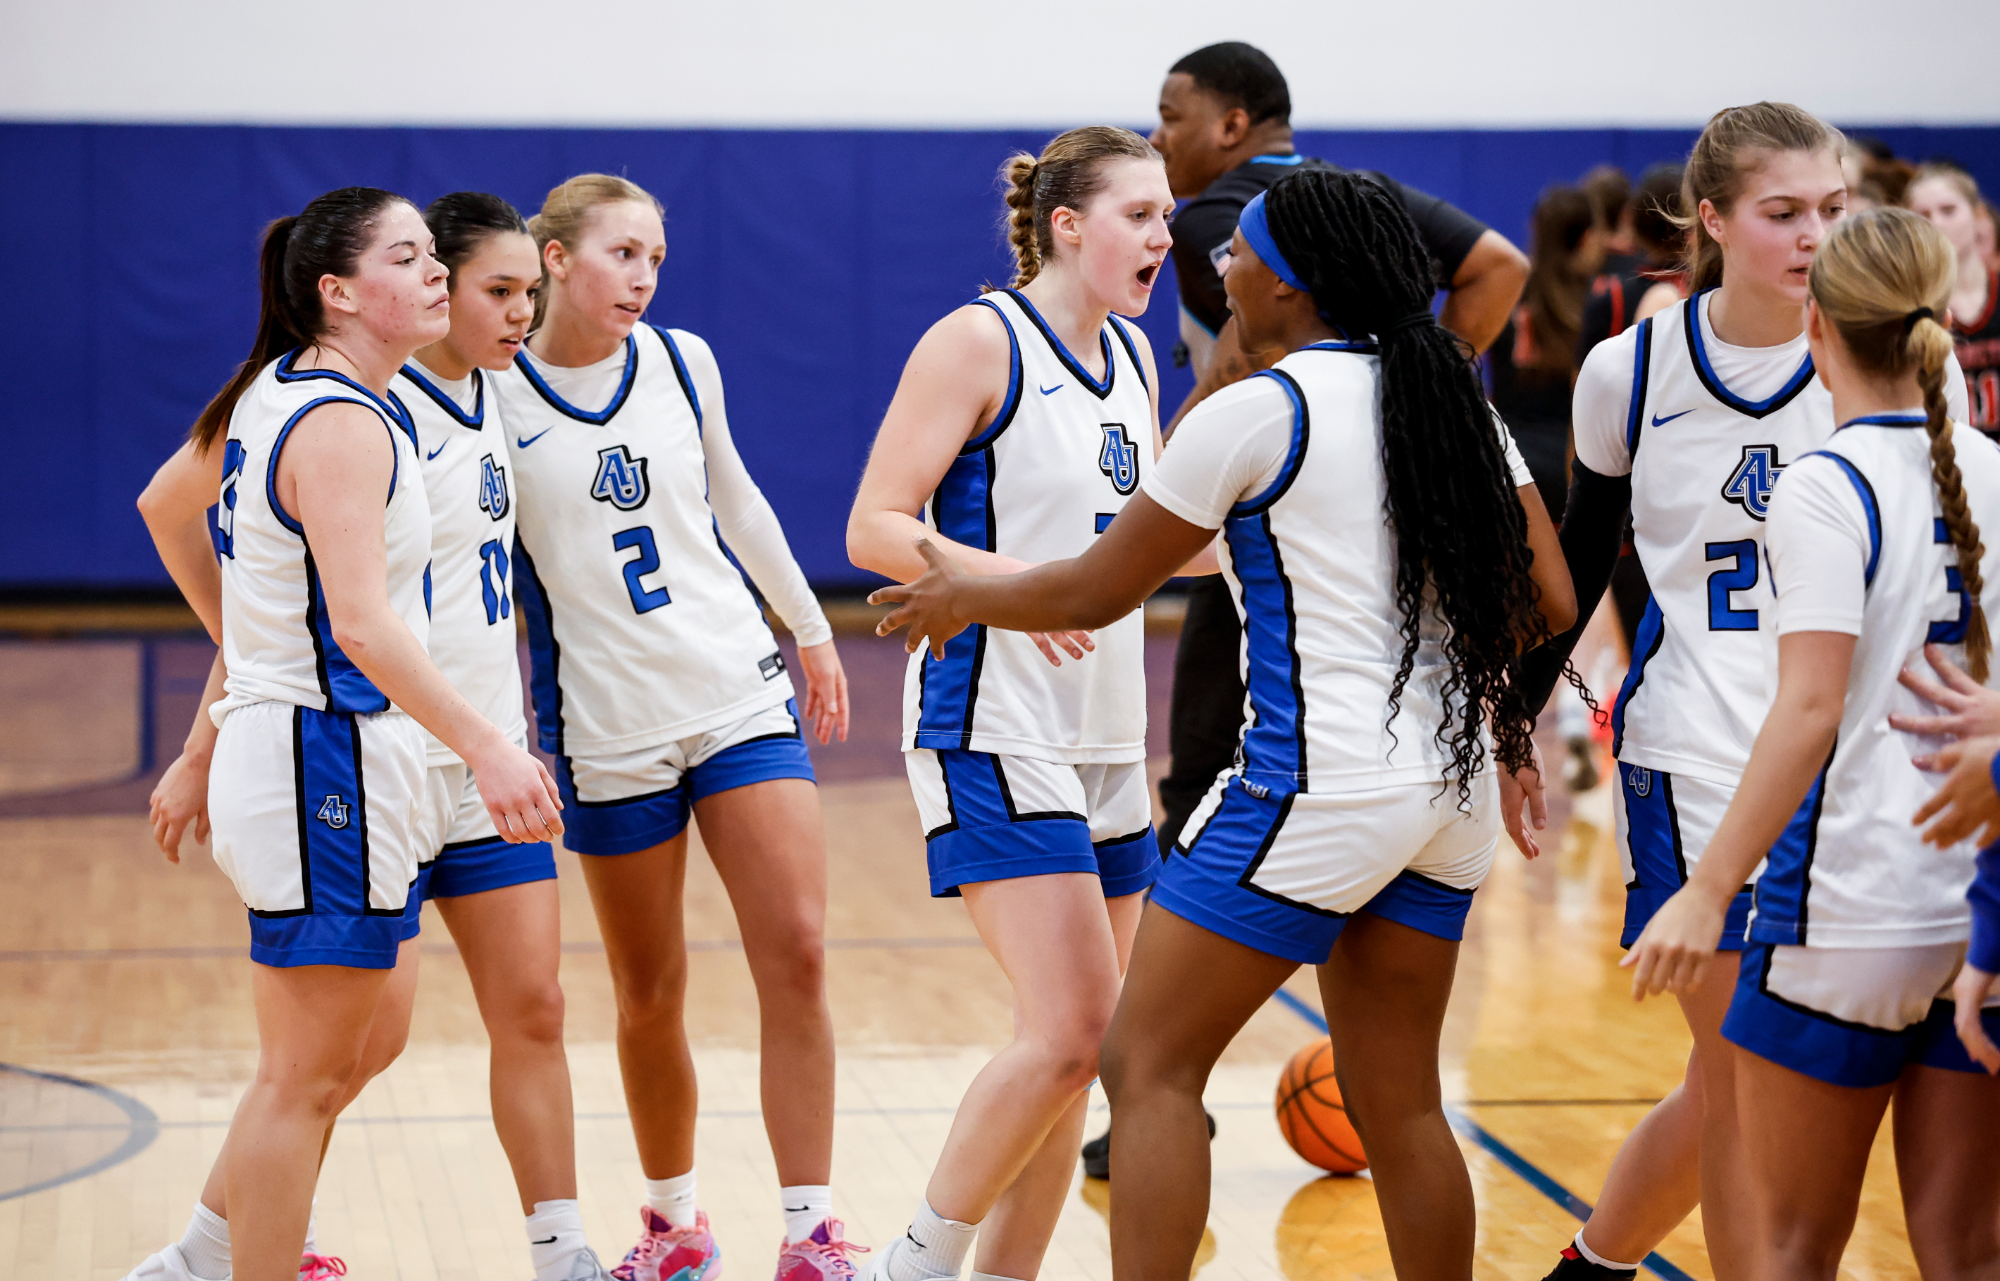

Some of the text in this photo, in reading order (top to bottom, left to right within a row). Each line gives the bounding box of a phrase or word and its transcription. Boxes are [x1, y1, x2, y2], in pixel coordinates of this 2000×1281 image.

[478, 452, 510, 522] AU
[590, 443, 651, 512] AU
[1099, 422, 1140, 496] AU
[612, 525, 672, 615] 2
[1704, 538, 1778, 632] 2
[316, 794, 352, 830] AU
